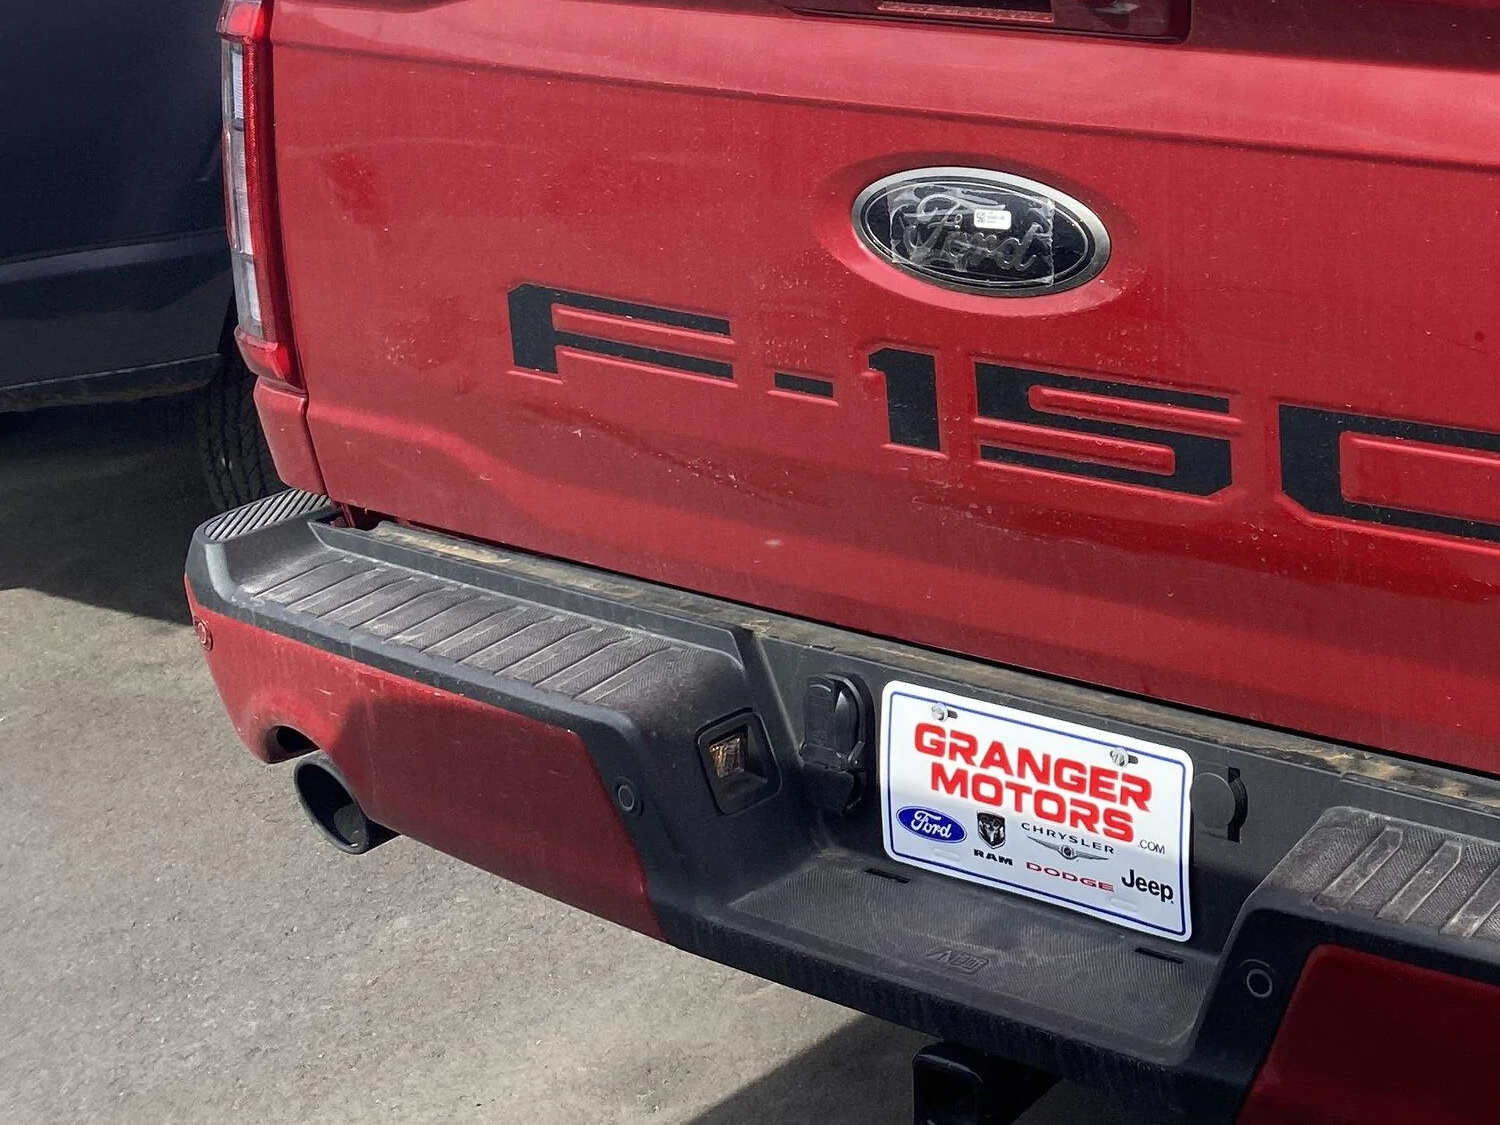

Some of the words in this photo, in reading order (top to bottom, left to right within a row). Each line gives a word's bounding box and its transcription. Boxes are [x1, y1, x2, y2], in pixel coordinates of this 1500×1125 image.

[914, 721, 1153, 813] GRANGER
[930, 762, 1135, 844] MOTORS
[911, 810, 953, 839] Ford
[1021, 821, 1116, 855] CHRYSLER
[973, 848, 1014, 867] RAM
[1026, 861, 1115, 893] DODGE
[1121, 868, 1174, 904] Jeep
